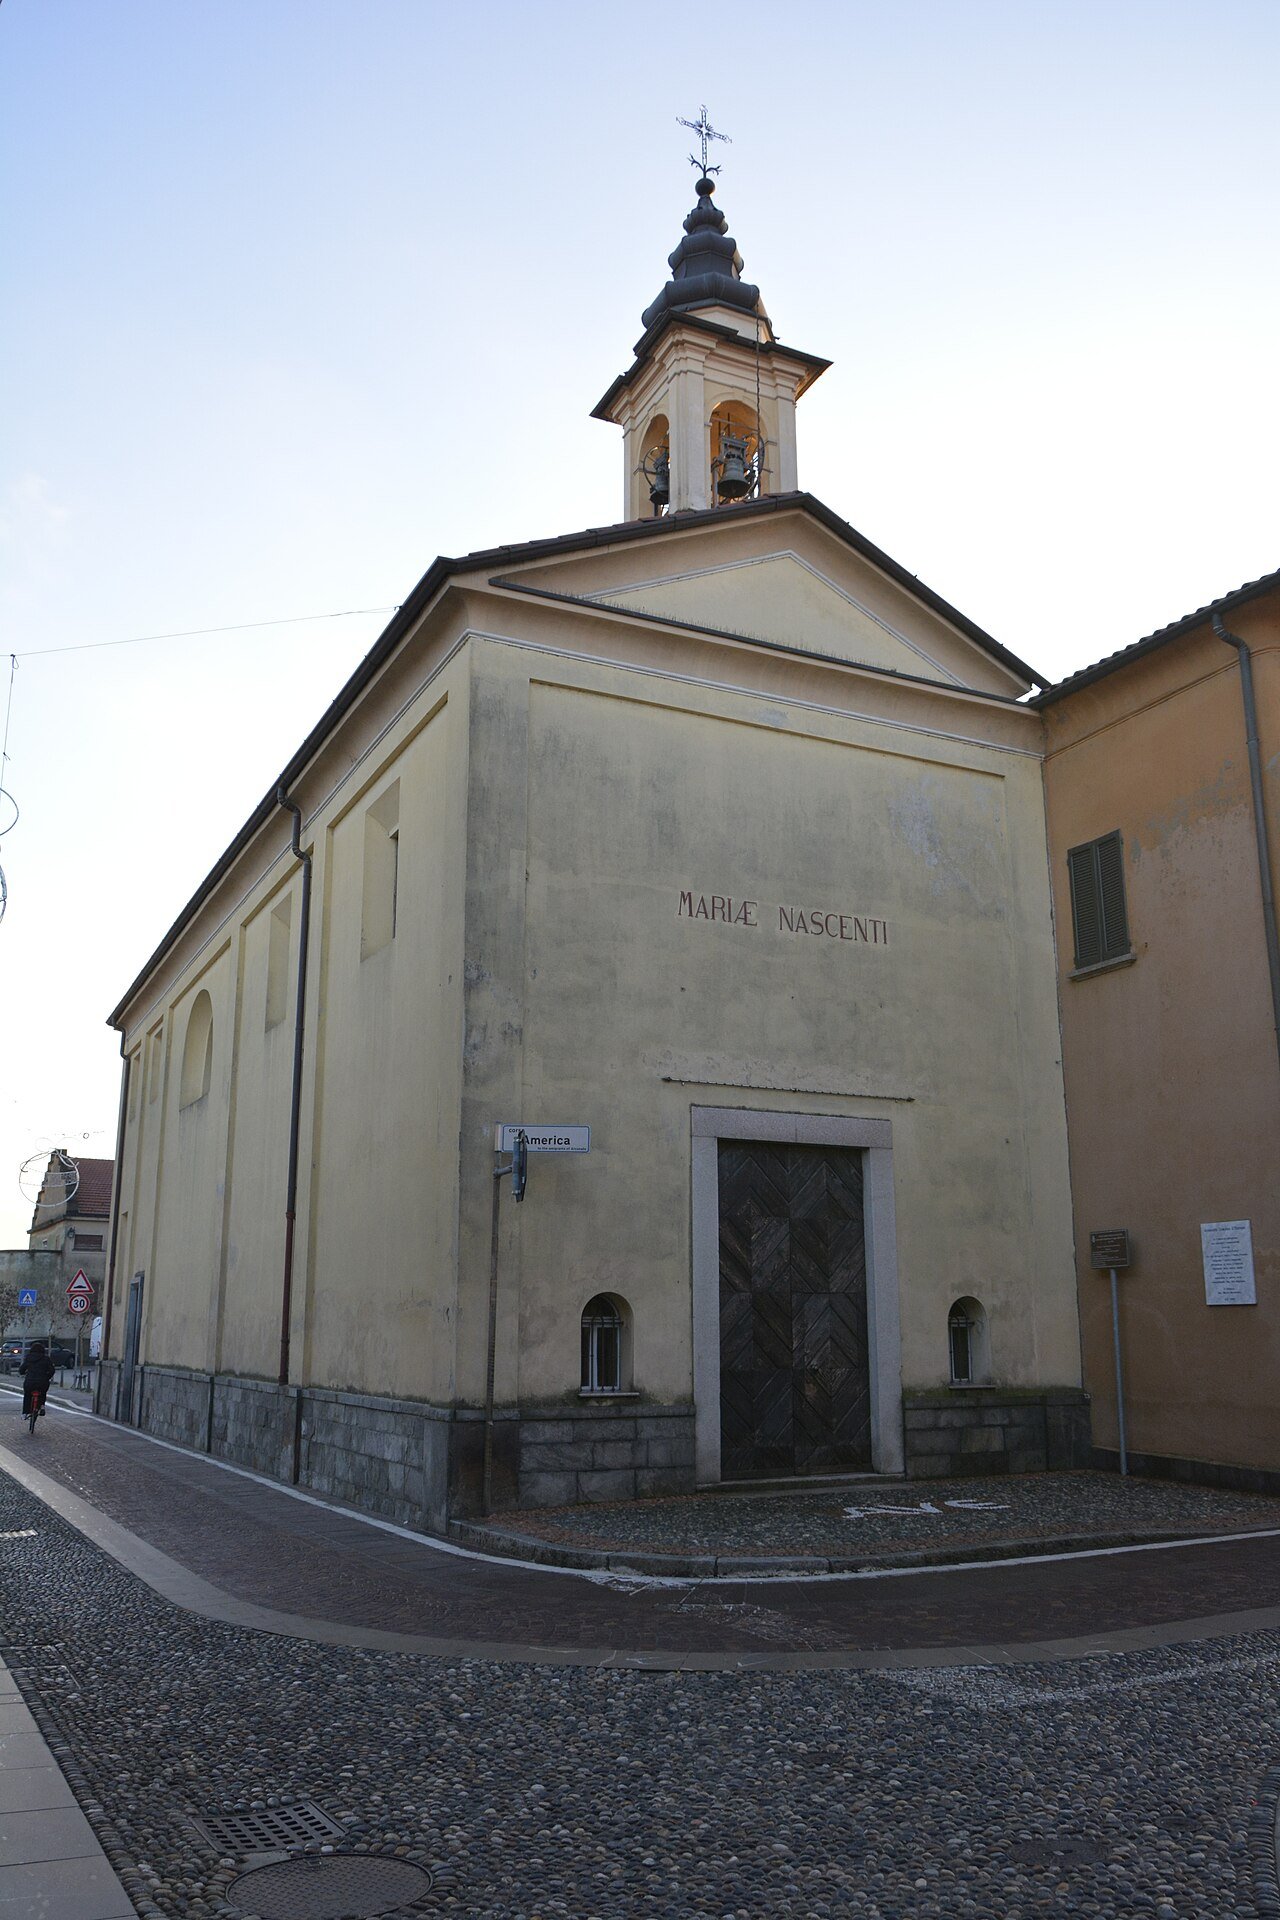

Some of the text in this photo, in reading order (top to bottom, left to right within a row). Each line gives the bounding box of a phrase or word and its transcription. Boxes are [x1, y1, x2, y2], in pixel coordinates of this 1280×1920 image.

[678, 890, 888, 945] MARIÆ NASCENTI
[525, 1135, 570, 1145] America
[73, 1299, 85, 1309] 30
